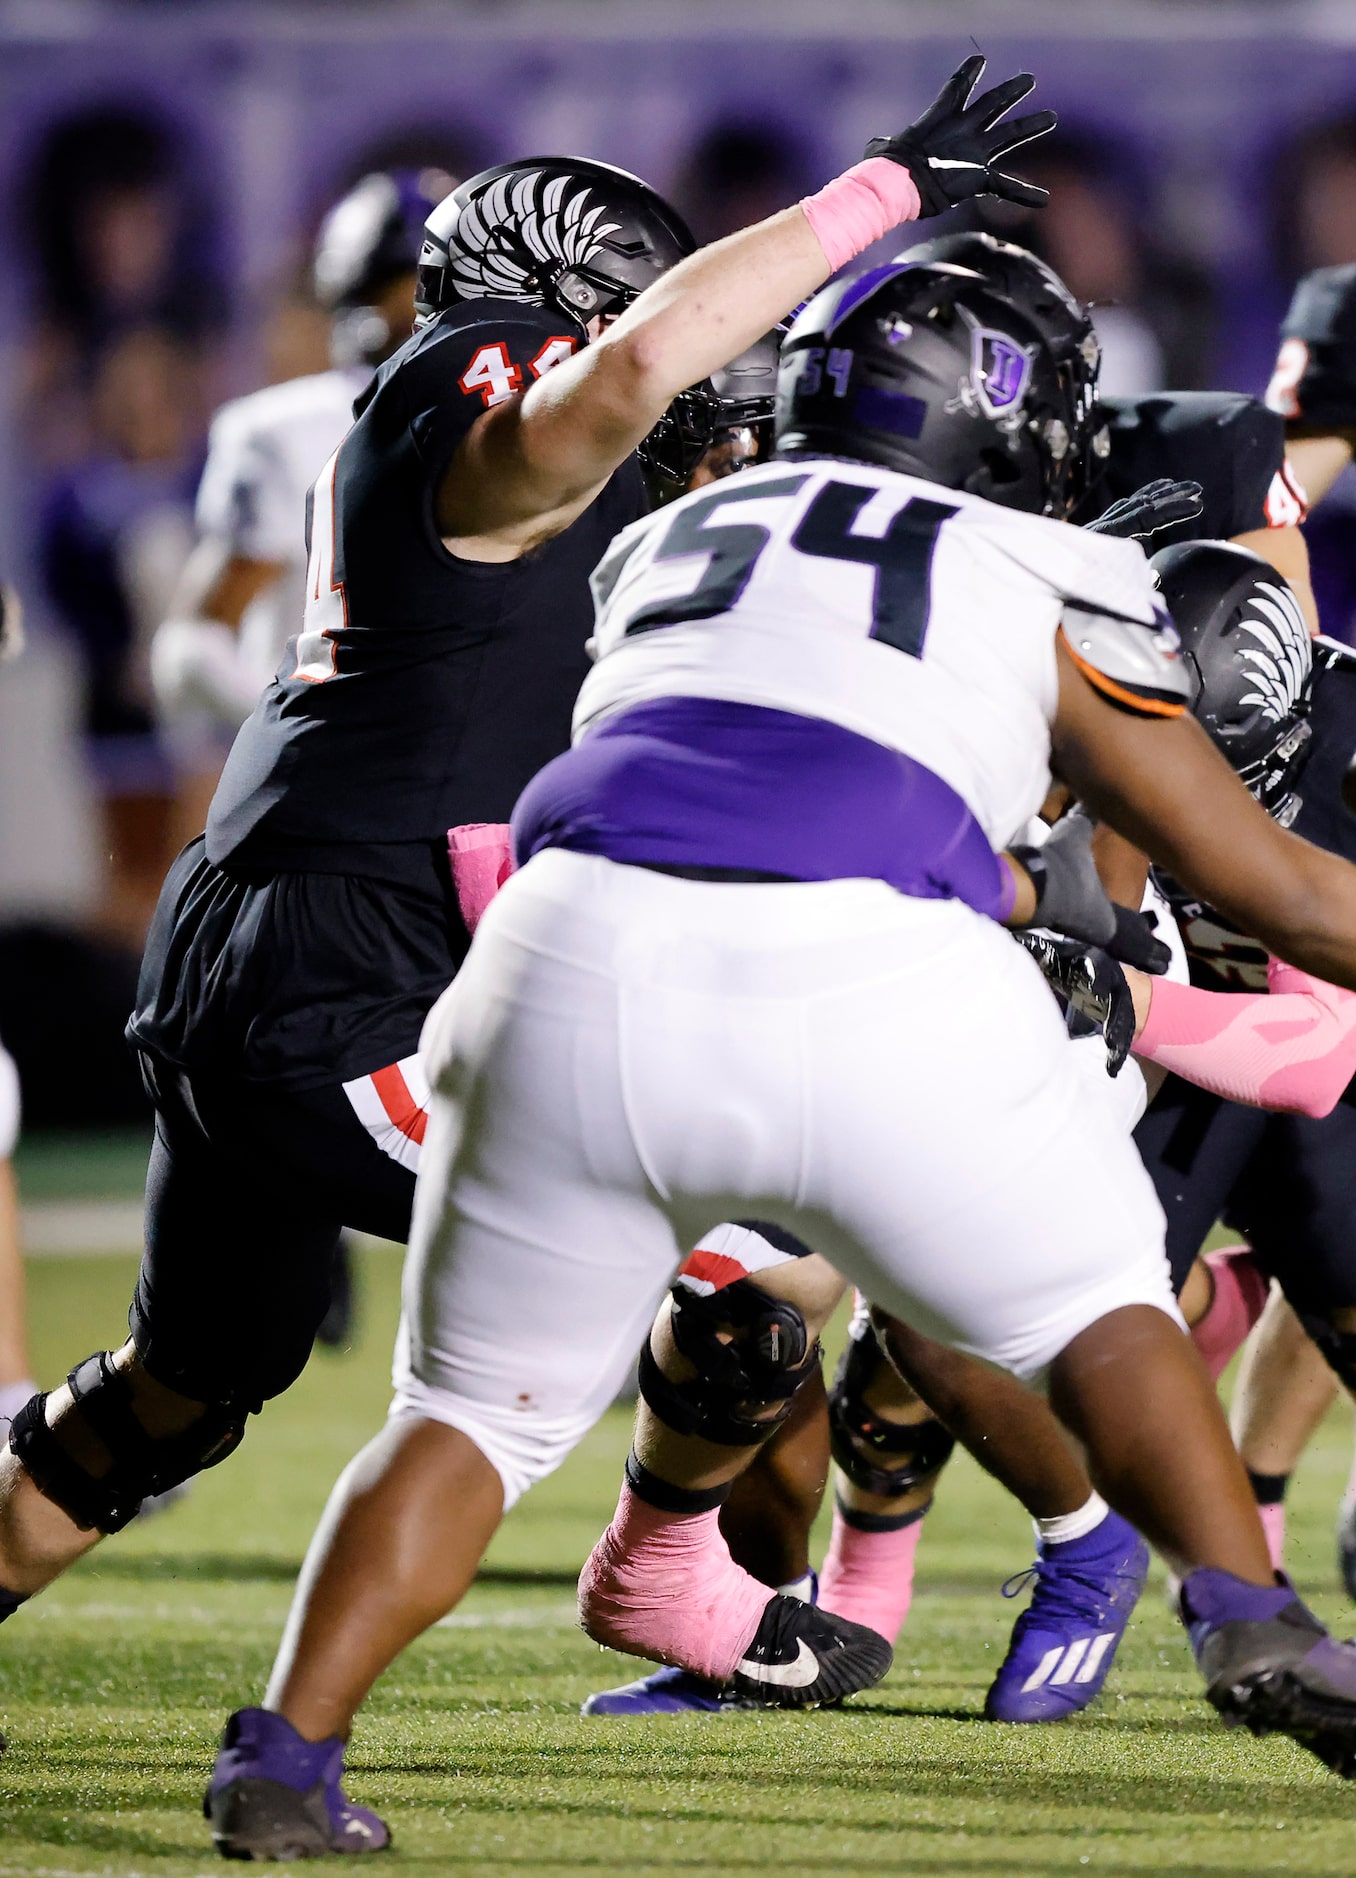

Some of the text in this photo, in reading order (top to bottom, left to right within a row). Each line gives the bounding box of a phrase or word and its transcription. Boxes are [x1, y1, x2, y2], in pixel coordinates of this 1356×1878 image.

[803, 349, 853, 398] 54
[1263, 457, 1310, 529] 4
[624, 473, 963, 661] 54
